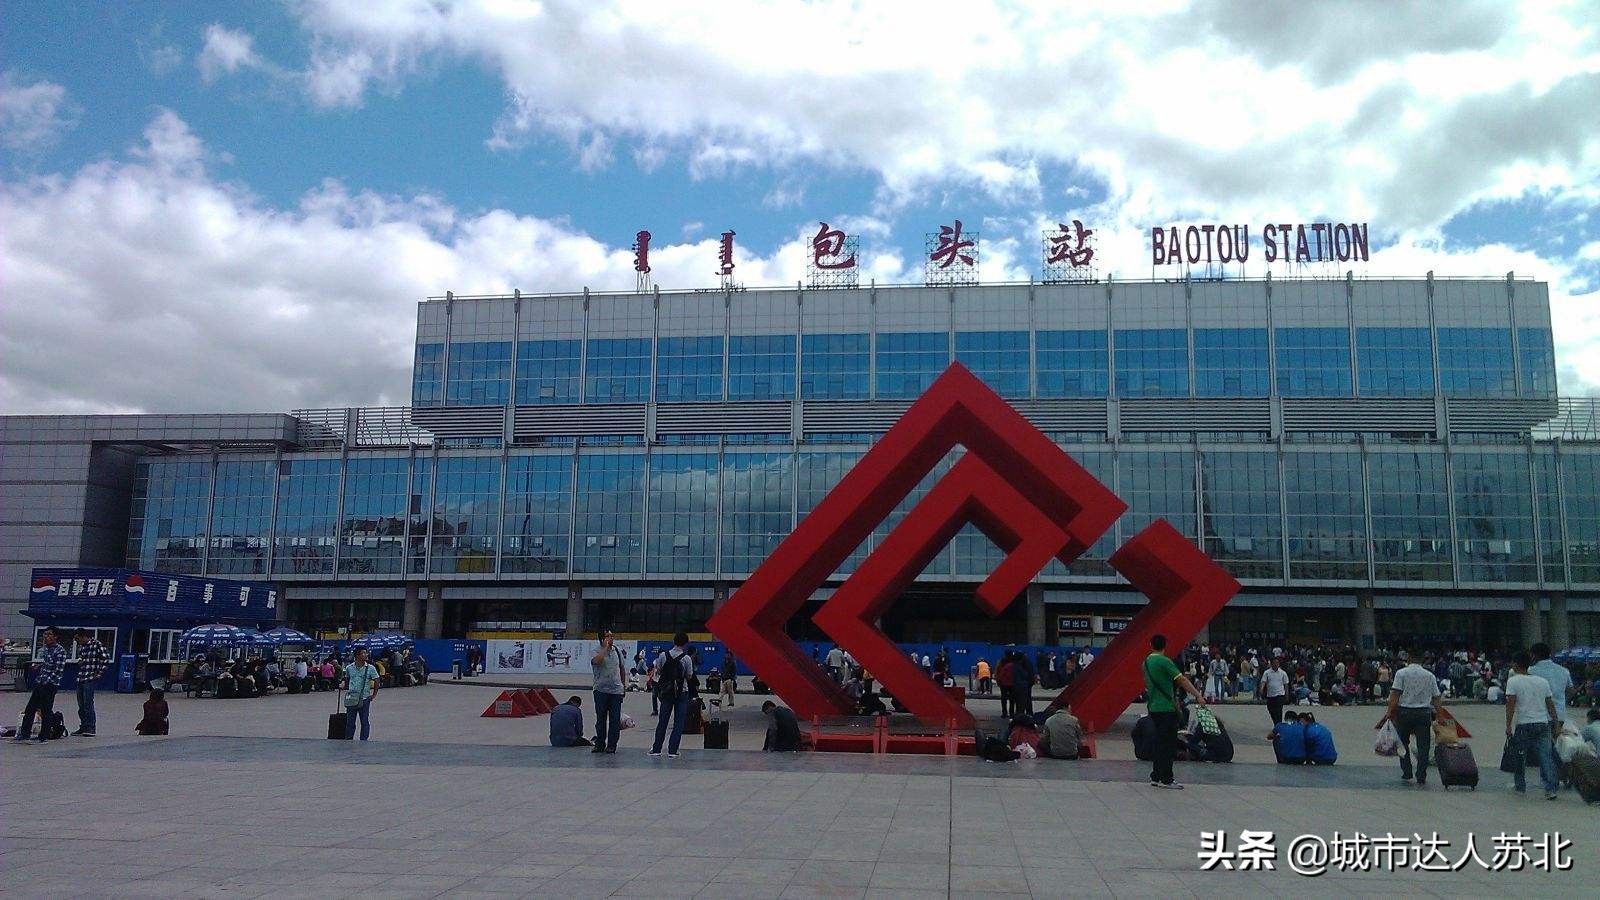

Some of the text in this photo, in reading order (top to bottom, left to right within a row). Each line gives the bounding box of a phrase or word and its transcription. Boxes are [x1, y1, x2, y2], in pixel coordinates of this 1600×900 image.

[812, 220, 1094, 269] 包头站
[1153, 223, 1369, 265] BAOTOU STATION
[58, 578, 114, 597] 百事可乐
[166, 580, 276, 609] 百事可乐
